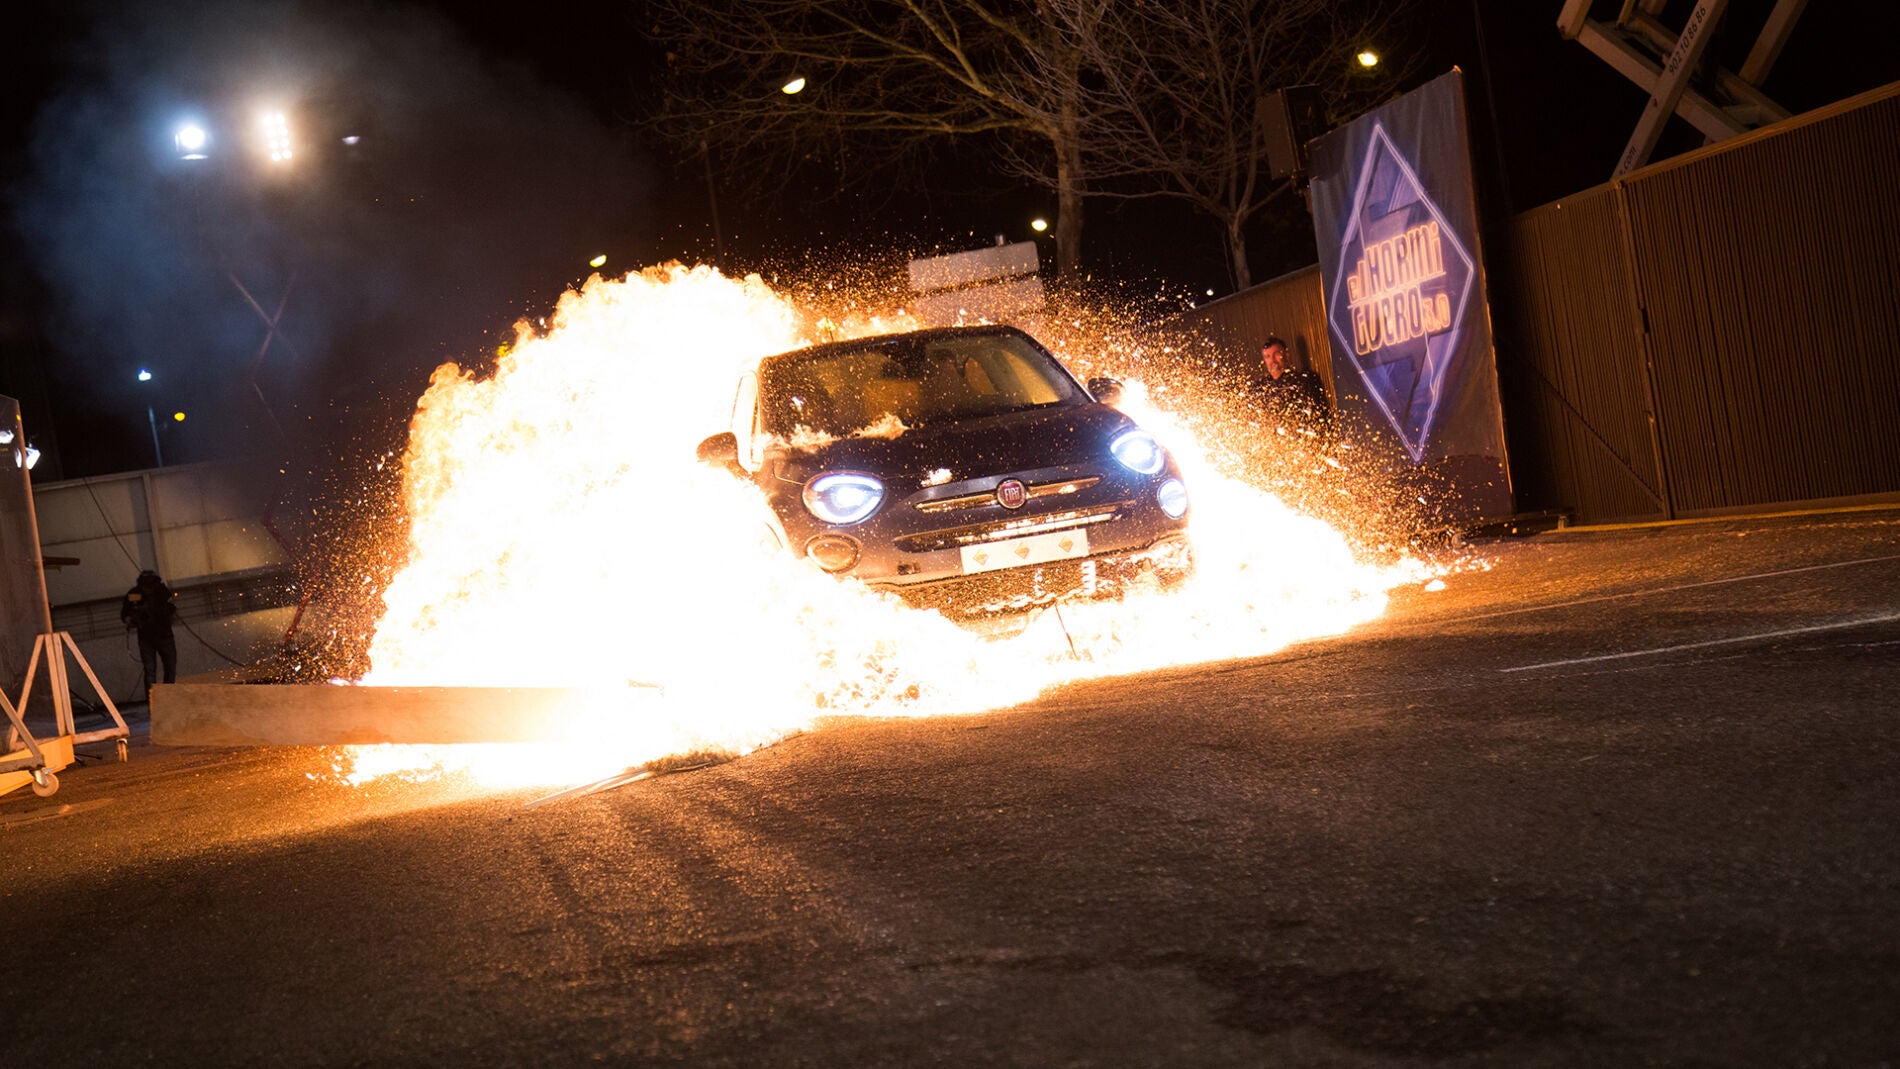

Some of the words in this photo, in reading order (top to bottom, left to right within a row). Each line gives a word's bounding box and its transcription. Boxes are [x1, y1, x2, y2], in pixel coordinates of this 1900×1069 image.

[1669, 51, 1682, 76] 902
[1680, 36, 1690, 54] 10
[1687, 21, 1698, 40] 86
[1695, 6, 1706, 24] 86
[1004, 487, 1020, 502] FIAT
